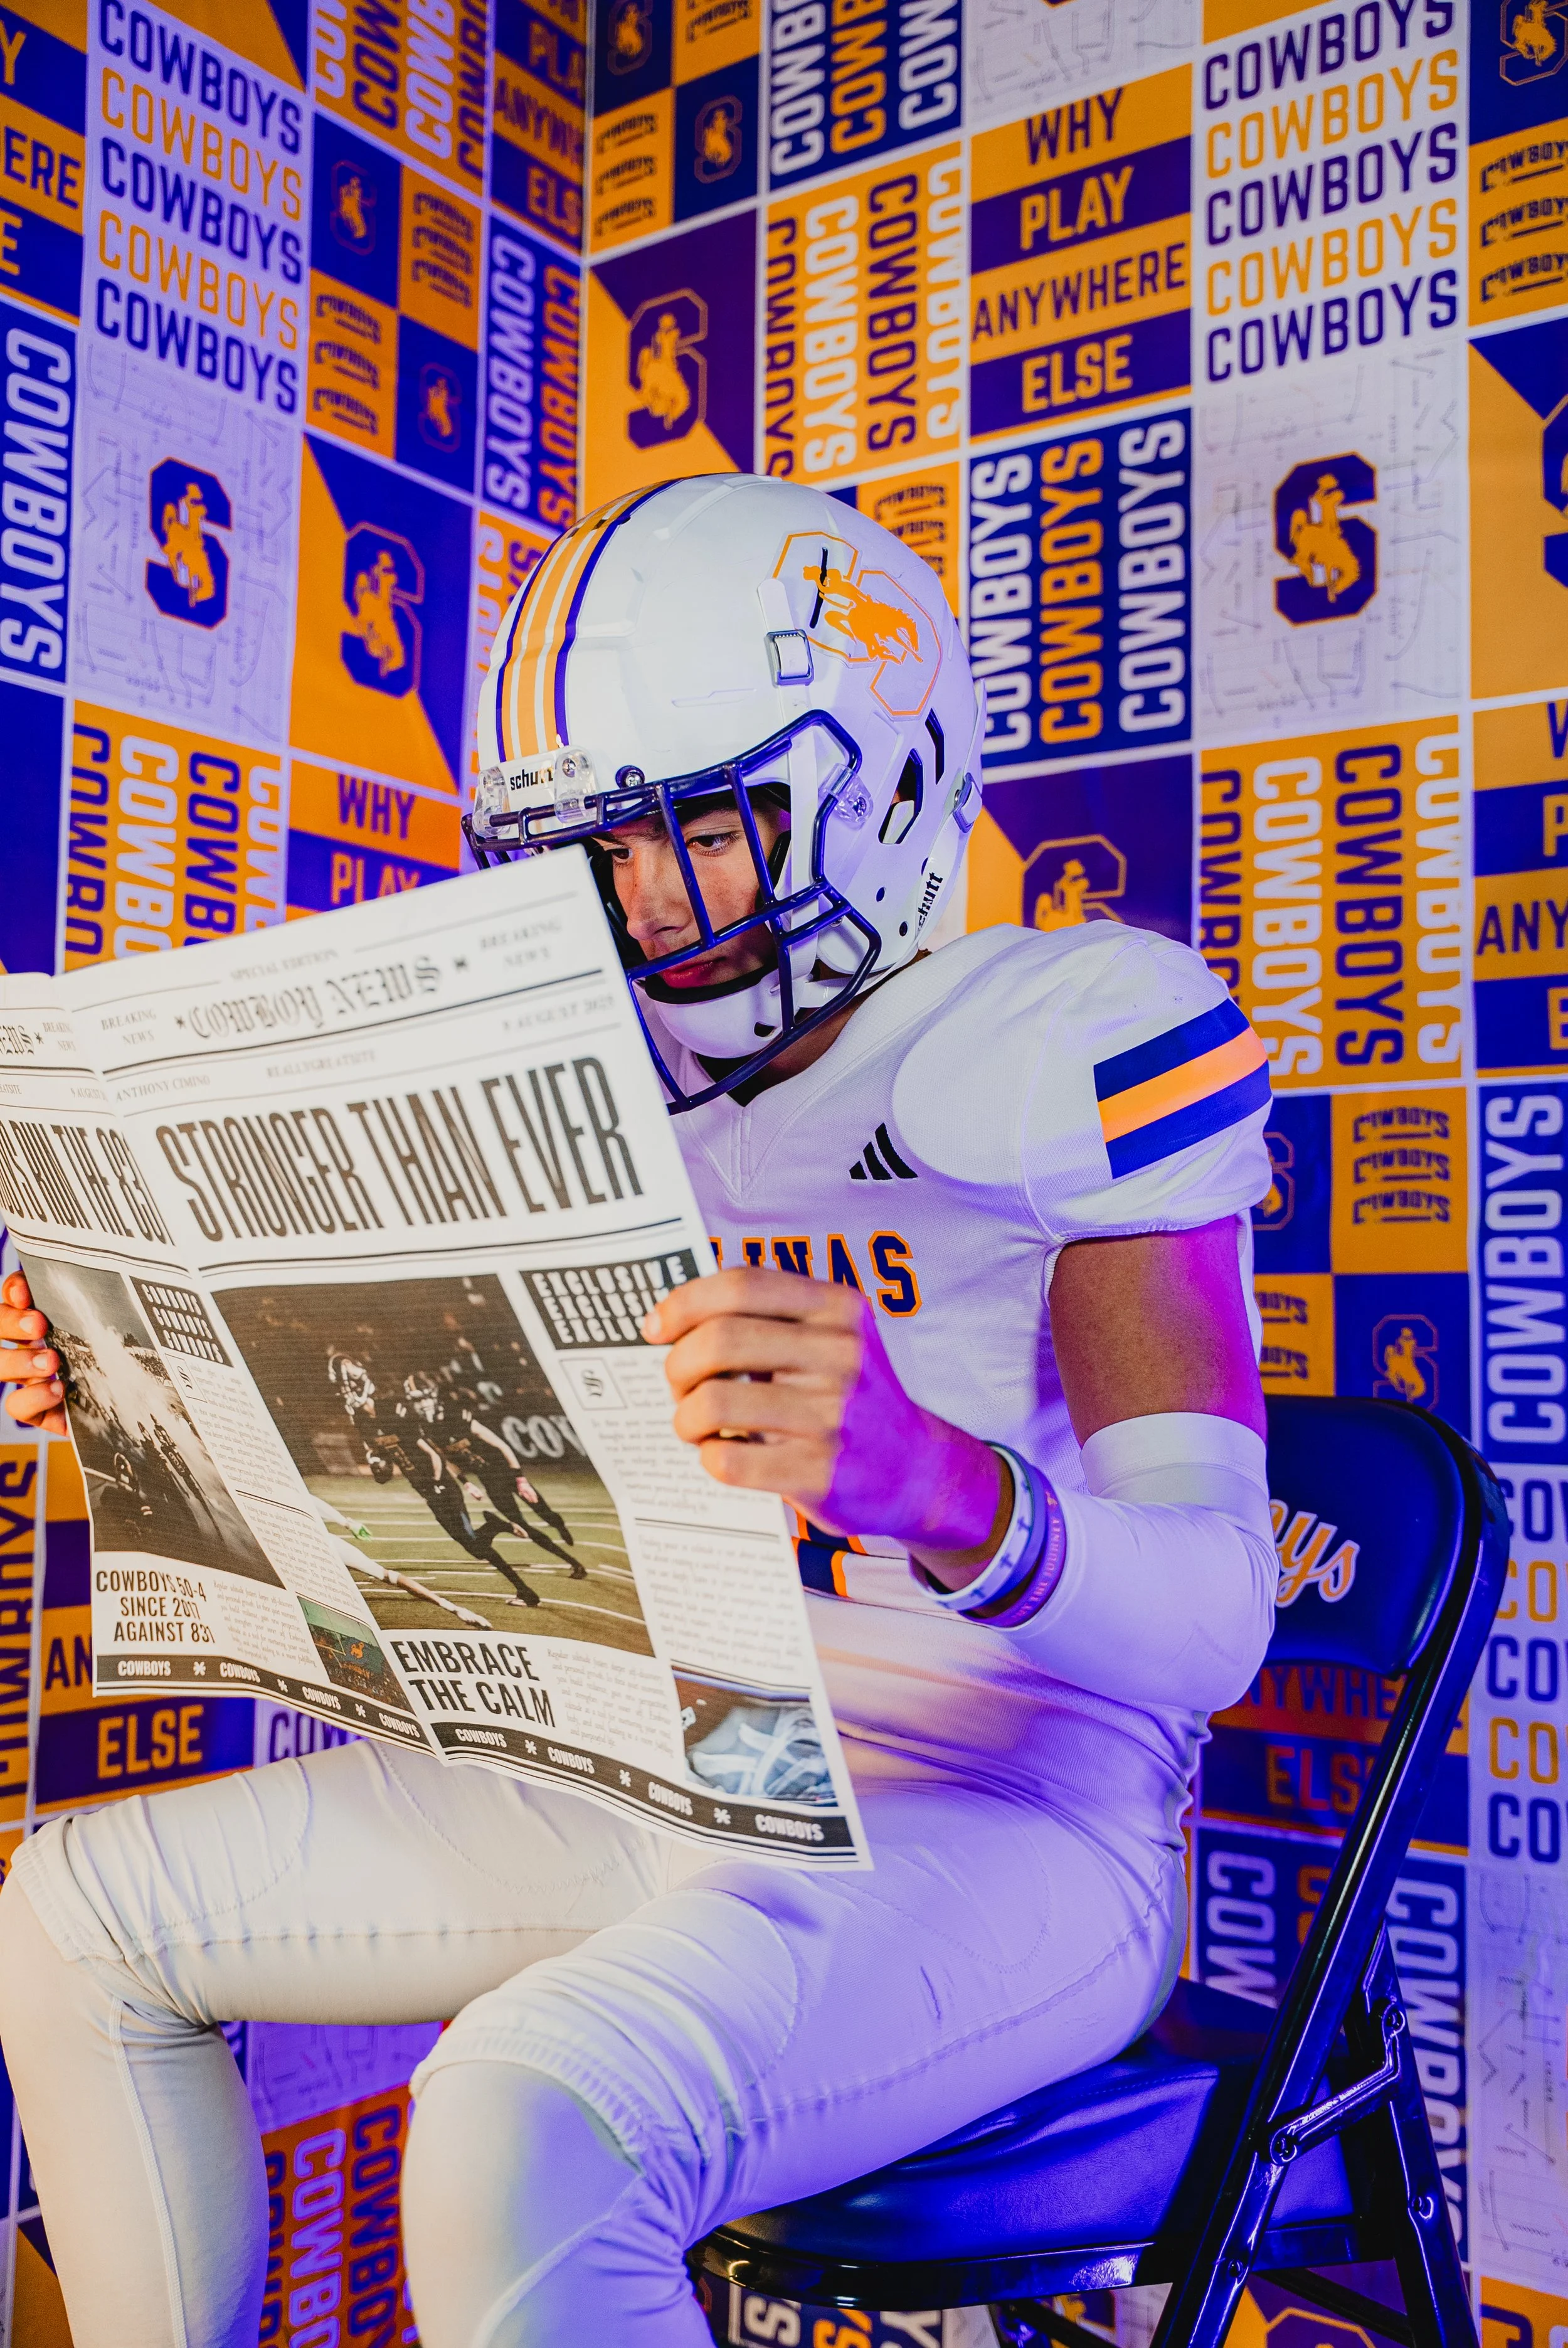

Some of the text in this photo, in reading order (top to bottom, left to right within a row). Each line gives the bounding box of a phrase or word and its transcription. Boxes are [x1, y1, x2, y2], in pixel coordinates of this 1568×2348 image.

[99, 0, 302, 156] COWBOYS
[1204, 0, 1454, 111] COWBOYS
[102, 67, 302, 222] COWBOYS
[1024, 87, 1126, 166] WHY
[1207, 48, 1459, 178] COWBOYS
[102, 137, 302, 284] COWBOYS
[1020, 166, 1135, 251] PLAY
[1207, 122, 1458, 247] COWBOYS
[98, 210, 299, 351] COWBOYS
[866, 173, 918, 451] COWBOYS
[971, 242, 1187, 343] ANYWHERE
[1207, 198, 1458, 316] COWBOYS
[95, 279, 297, 415] COWBOYS
[485, 234, 537, 509] COWBOYS
[803, 195, 859, 473] COWBOYS
[1022, 334, 1134, 414] ELSE
[1207, 268, 1459, 383] COWBOYS
[0, 327, 72, 670] COWBOYS
[971, 453, 1033, 754] COWBOYS
[1039, 438, 1104, 745] COWBOYS
[1118, 419, 1185, 733] COWBOYS
[182, 751, 240, 946] COWB
[337, 773, 416, 841] WHY
[1252, 756, 1323, 1076] COWBOYS
[1335, 743, 1405, 1065] COWBOYS
[101, 1009, 157, 1030] BREAKING
[122, 1031, 155, 1046] NEWS
[115, 1080, 170, 1103] ANTHONY
[156, 1107, 386, 1243] STRONGER
[346, 1085, 508, 1226] THAN
[479, 1056, 644, 1214] EVER
[141, 1283, 202, 1316] COWBOYS
[152, 1307, 213, 1340] COWBOYS
[531, 1255, 687, 1299] EXCLUSIVE
[1485, 1094, 1565, 1443] COWBOYS
[162, 1330, 224, 1364] COWBOYS
[96, 1570, 207, 1602] COWBOYS 50-4
[114, 1622, 216, 1644] AGAINST 831
[120, 1596, 201, 1620] SINCE 2017
[117, 1660, 171, 1677] COWBOYS
[220, 1662, 261, 1684] COWBOYS
[302, 1686, 342, 1711] COWBOYS
[378, 1712, 421, 1738] COWBOYS
[390, 1640, 540, 1681] EMBRACE
[408, 1679, 477, 1713] THE
[475, 1681, 556, 1728] CALM
[97, 1704, 206, 1780] ELSE
[455, 1728, 825, 1842] COWBOYS COWBOYS COWBOYS COWBOYS
